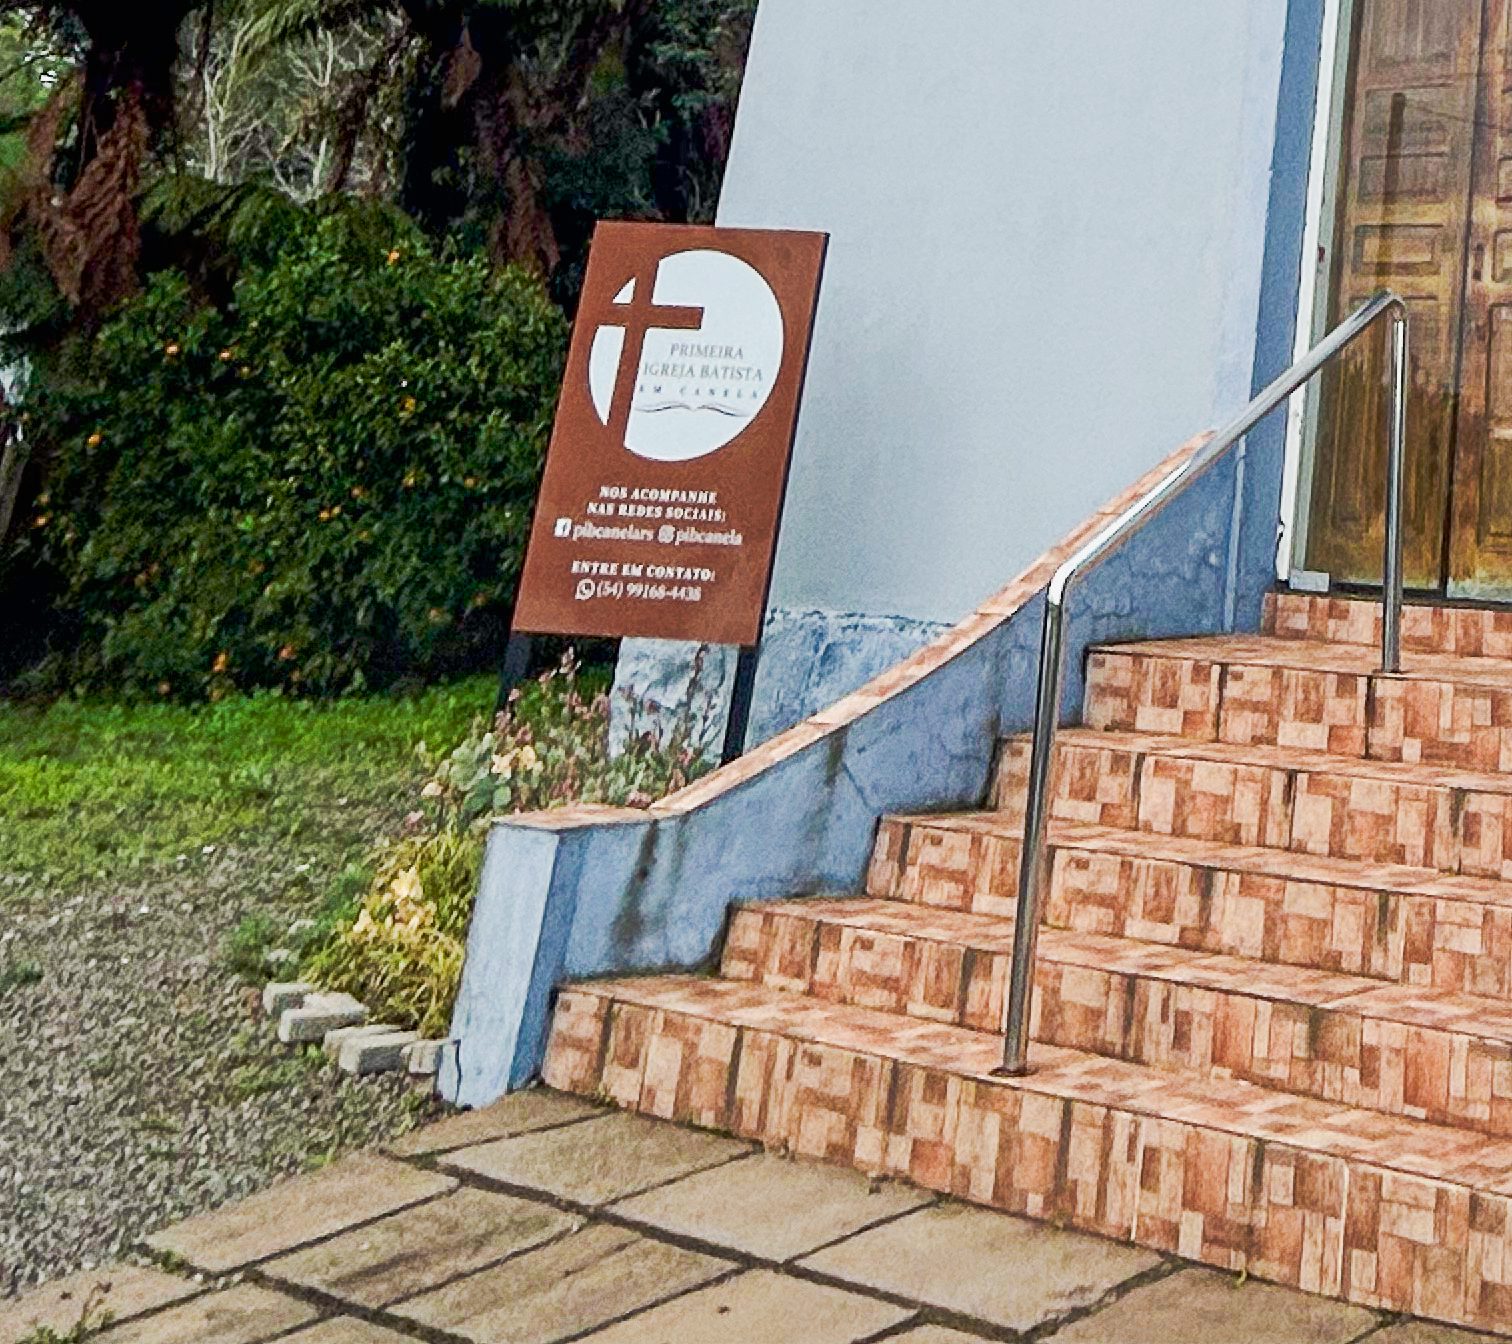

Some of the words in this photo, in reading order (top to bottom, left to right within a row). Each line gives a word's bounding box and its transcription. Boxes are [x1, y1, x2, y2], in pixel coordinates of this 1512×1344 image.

[670, 343, 744, 359] PRIMEIRA
[643, 363, 696, 378] IGREJA
[700, 365, 763, 381] BATISTA
[600, 486, 628, 499] NOS
[630, 488, 718, 505] ACOMPANHE
[587, 502, 615, 515] NAS
[618, 504, 663, 518] REDES
[571, 561, 620, 576] ENTRE
[621, 564, 644, 577] EM
[596, 580, 624, 600] (54)
